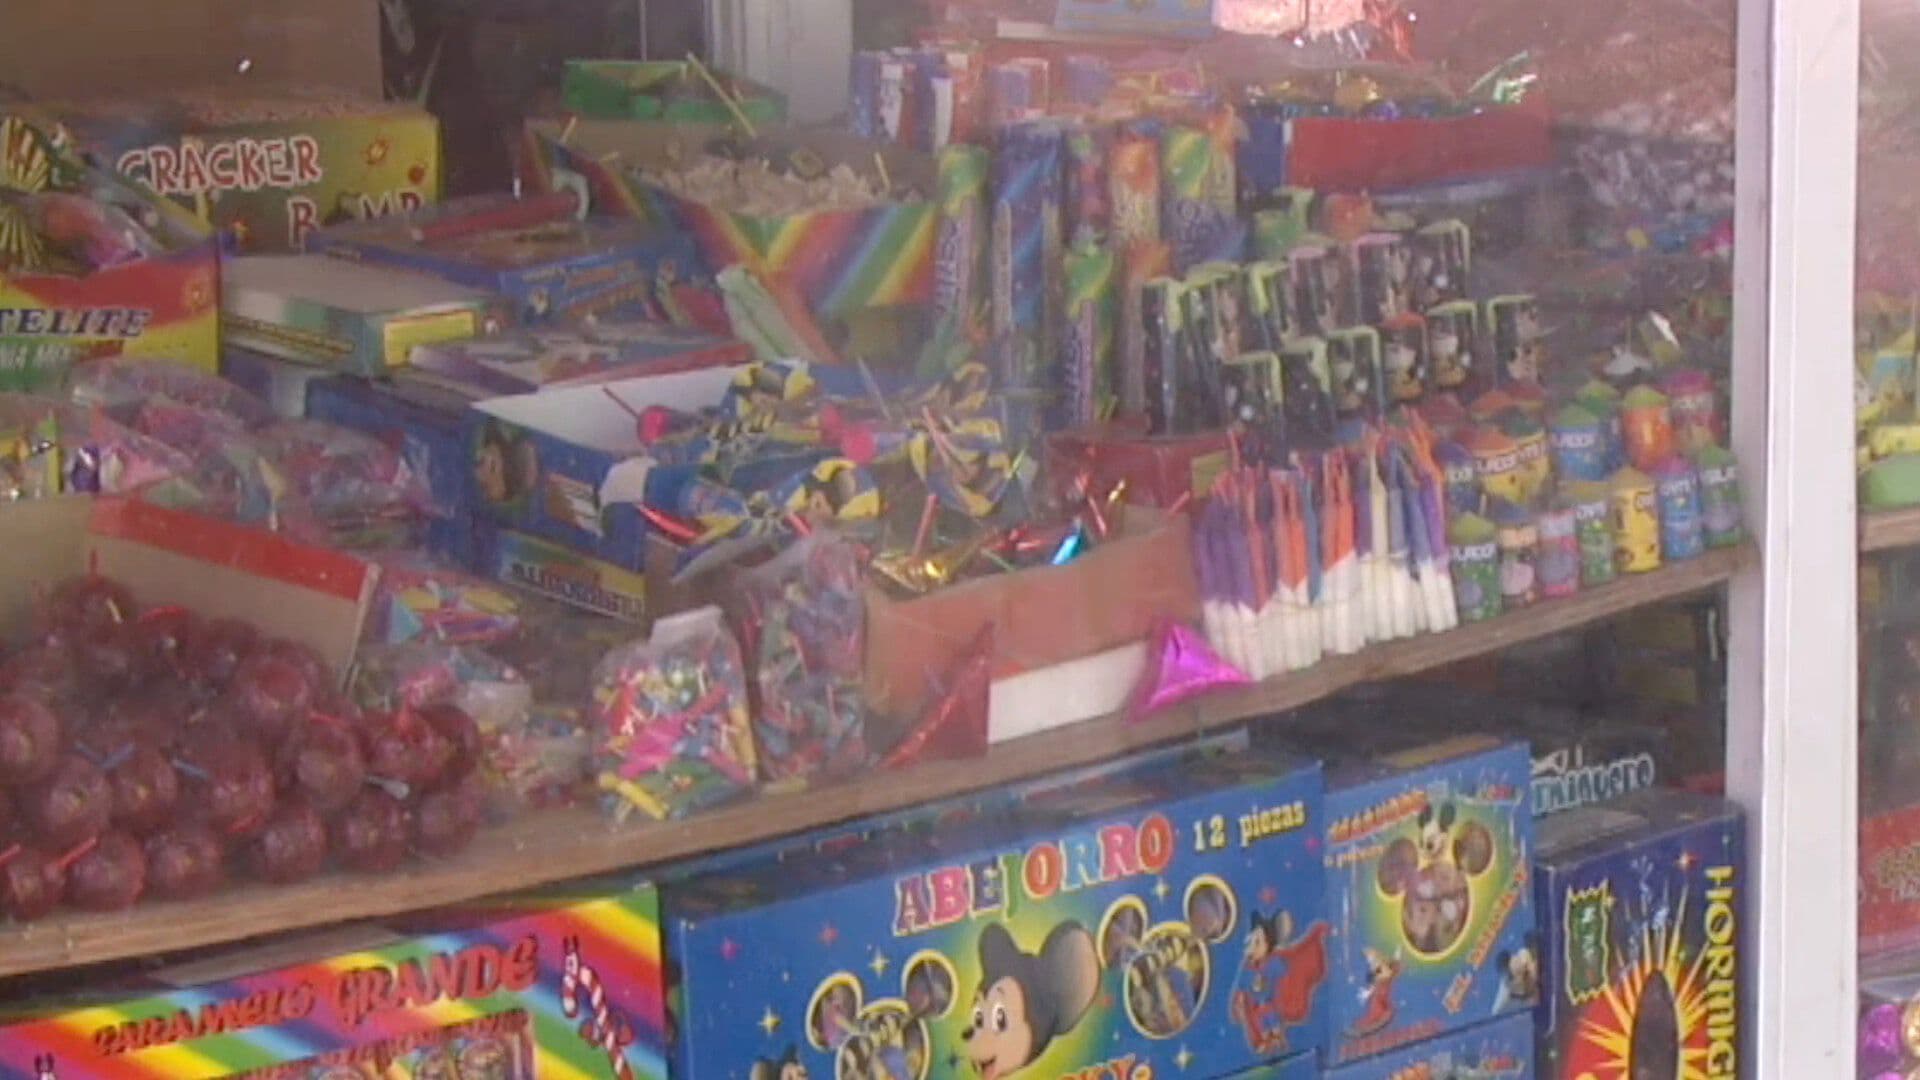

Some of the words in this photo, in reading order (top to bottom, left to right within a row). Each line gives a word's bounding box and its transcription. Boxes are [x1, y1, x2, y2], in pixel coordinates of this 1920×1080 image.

[116, 135, 323, 195] CRACKER
[893, 812, 1174, 937] ABEJORRO
[1193, 813, 1227, 851] 12
[1238, 800, 1306, 848] piezas
